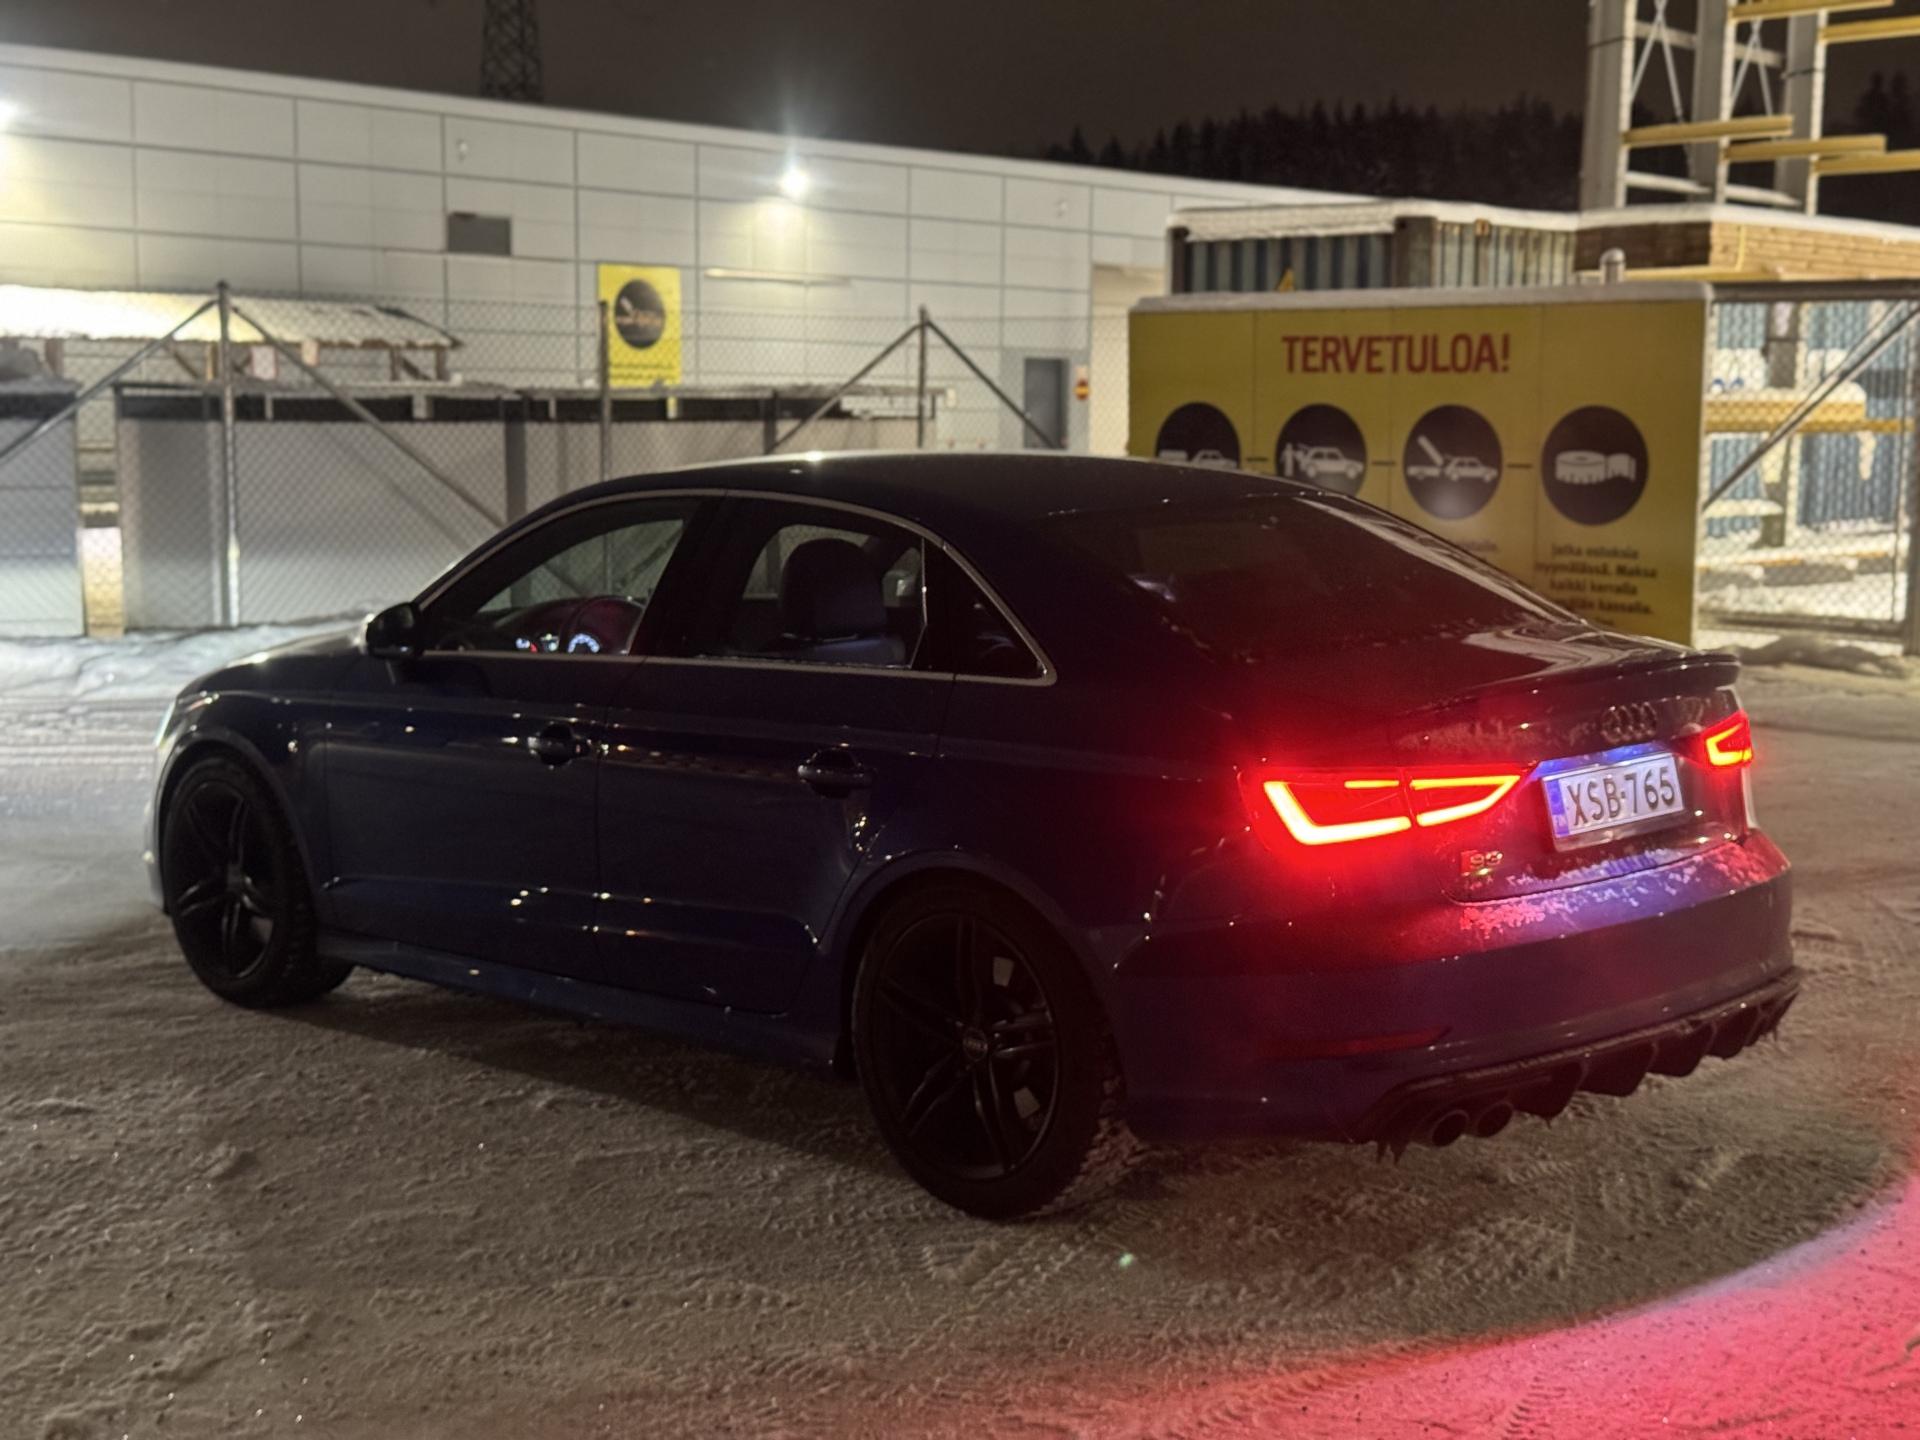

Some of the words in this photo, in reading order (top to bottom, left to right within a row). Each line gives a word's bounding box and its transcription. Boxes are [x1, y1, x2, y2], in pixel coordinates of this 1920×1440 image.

[1282, 333, 1510, 374] TERVETULOA!
[1616, 564, 1657, 579] Maksa
[1567, 766, 1676, 826] XSB-765
